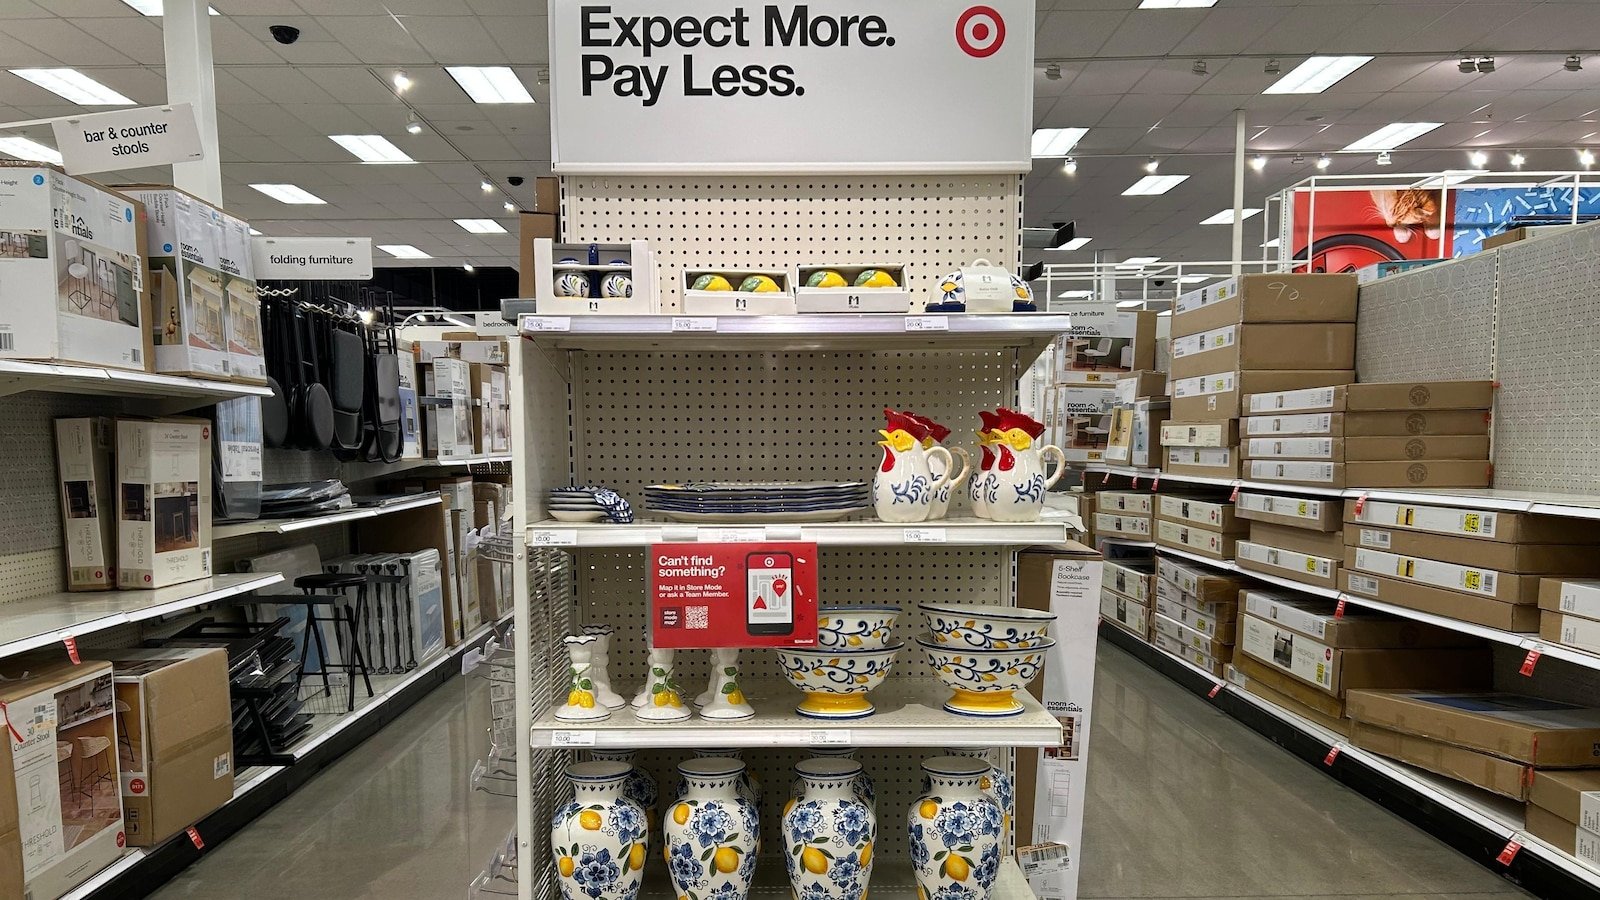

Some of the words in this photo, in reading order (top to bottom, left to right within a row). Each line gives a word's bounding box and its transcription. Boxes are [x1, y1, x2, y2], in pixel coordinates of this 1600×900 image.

[581, 5, 749, 57] Expect
[764, 6, 896, 47] More.
[581, 55, 669, 106] Pay
[683, 55, 805, 96] Less.
[84, 130, 104, 143] bar
[108, 127, 118, 140] &
[120, 122, 168, 138] counter
[112, 141, 150, 156] stools
[270, 254, 306, 266] folding
[308, 254, 353, 264] furniture
[659, 556, 688, 566] Can't
[690, 555, 713, 566] find
[658, 566, 726, 578] something?
[14, 738, 36, 751] Counter
[37, 730, 50, 742] Stool
